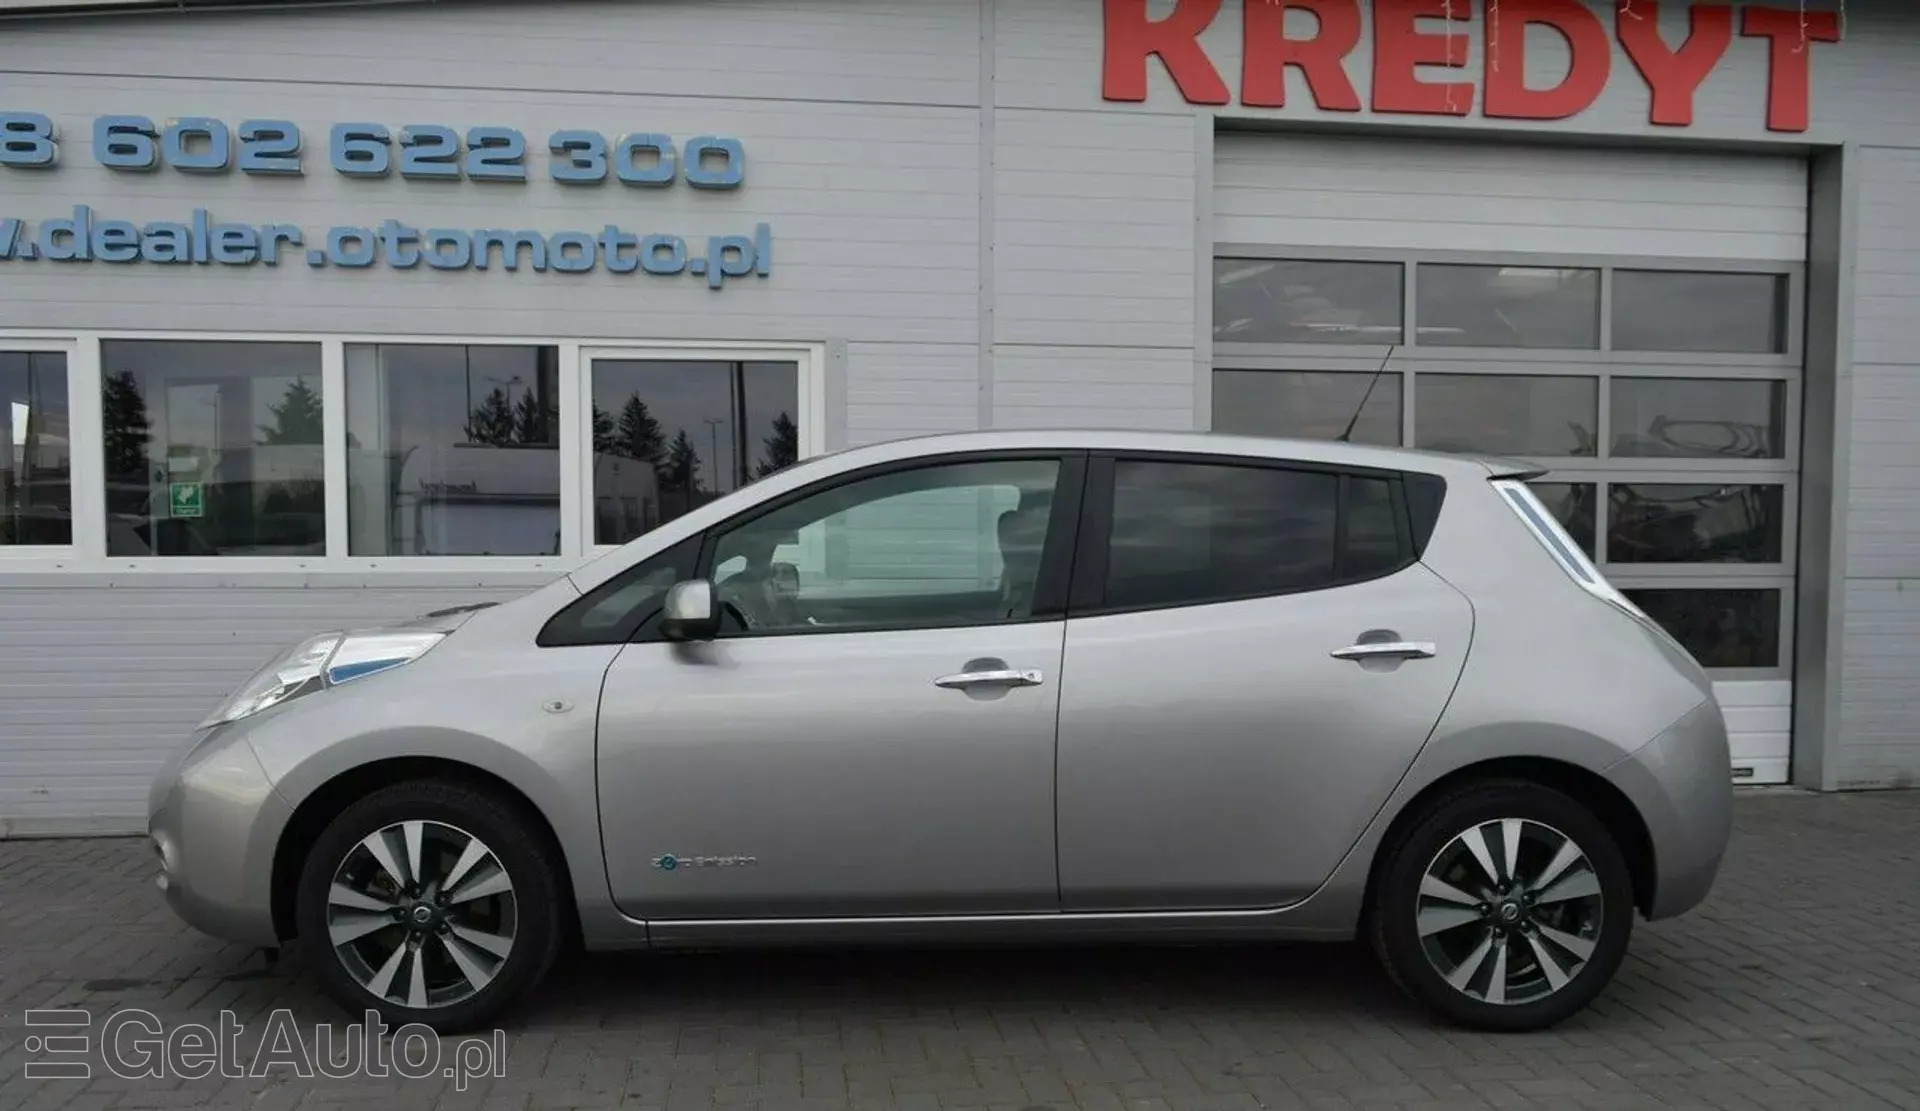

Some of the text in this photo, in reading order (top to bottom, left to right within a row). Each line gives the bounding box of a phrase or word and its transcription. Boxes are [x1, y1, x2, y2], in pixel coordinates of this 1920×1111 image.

[1102, 0, 1839, 131] KREDYT
[93, 115, 303, 175] 602
[330, 122, 526, 181] 622
[549, 130, 746, 189] 300
